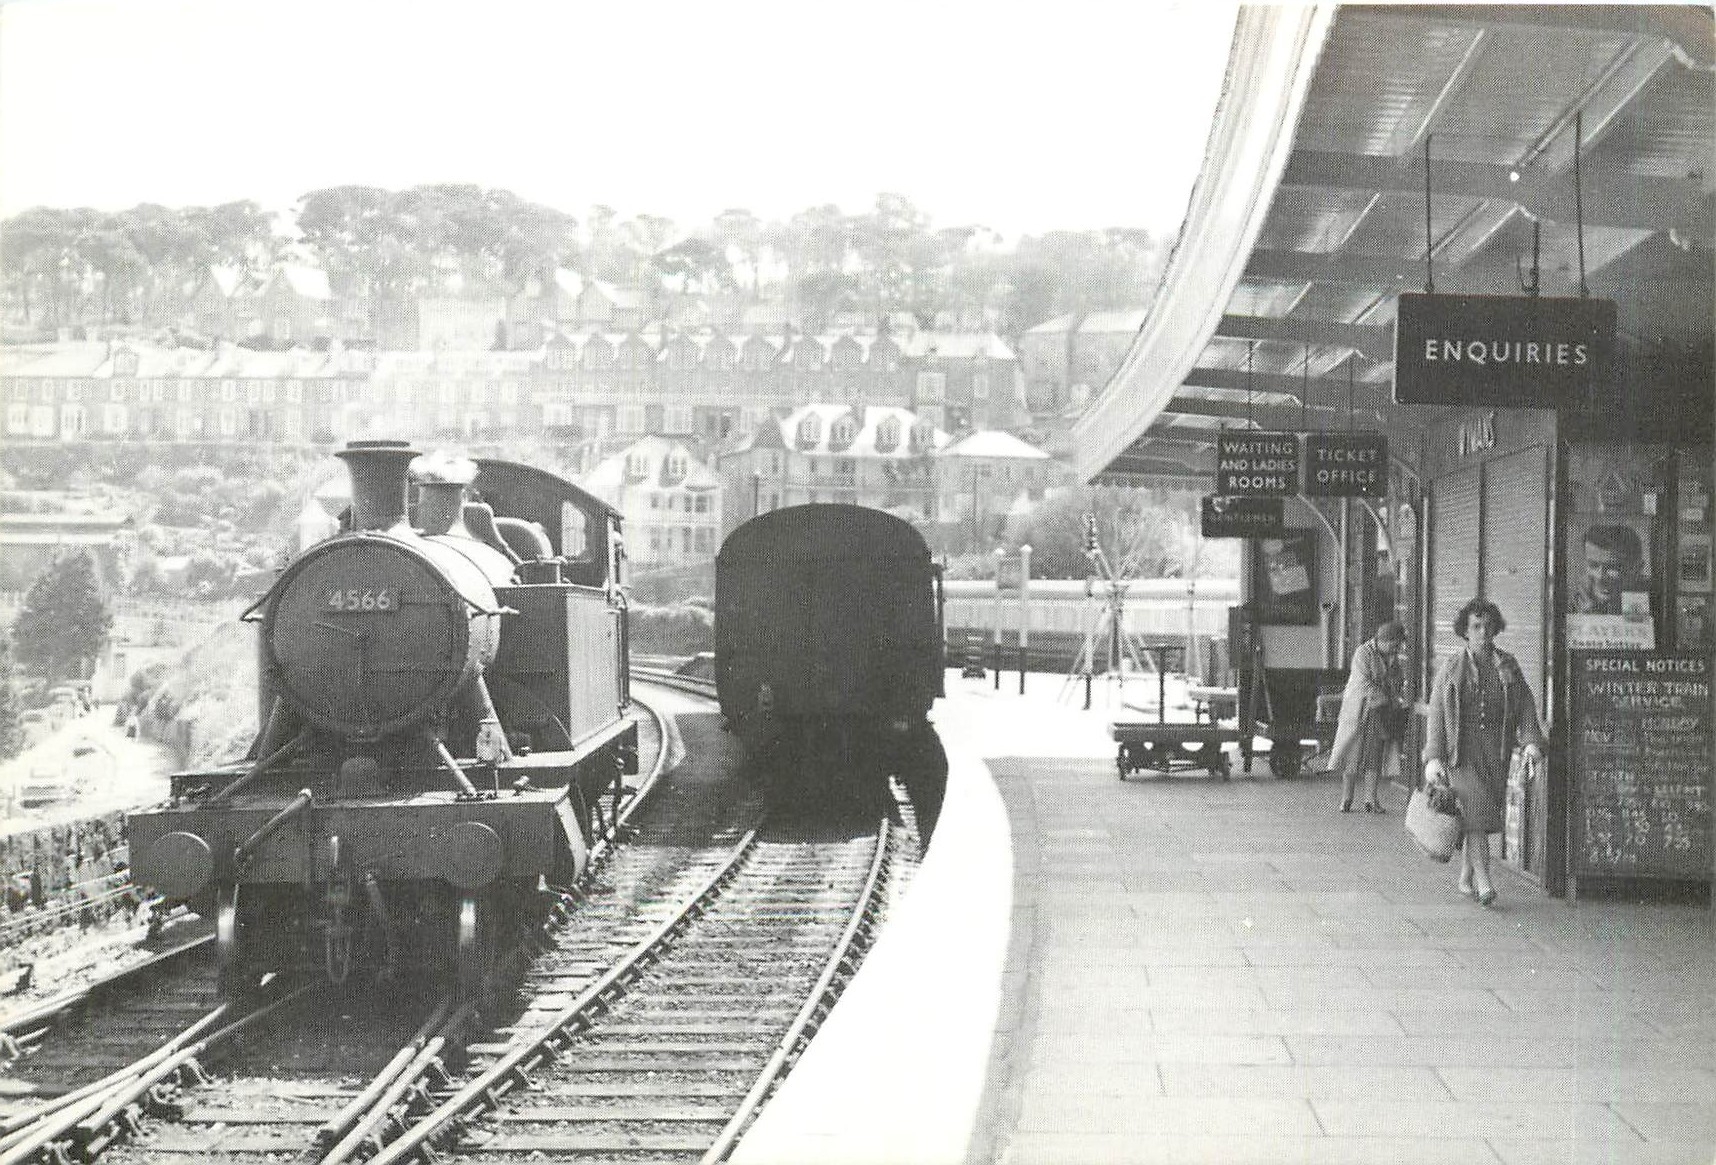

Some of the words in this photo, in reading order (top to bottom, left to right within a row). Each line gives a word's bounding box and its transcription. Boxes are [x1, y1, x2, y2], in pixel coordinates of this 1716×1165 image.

[1425, 339, 1588, 365] ENQUIRIES
[1223, 442, 1293, 455] WAITING
[1317, 449, 1378, 462] TICKET
[1220, 459, 1249, 471] AND
[1252, 460, 1296, 472] LADIES
[1229, 476, 1286, 490] ROOMS
[1316, 470, 1376, 484] OFFICE
[328, 589, 391, 611] 4566
[1585, 658, 1640, 672] SPECIAL
[1645, 659, 1706, 673] NOTICES
[1587, 681, 1657, 696] WINTER
